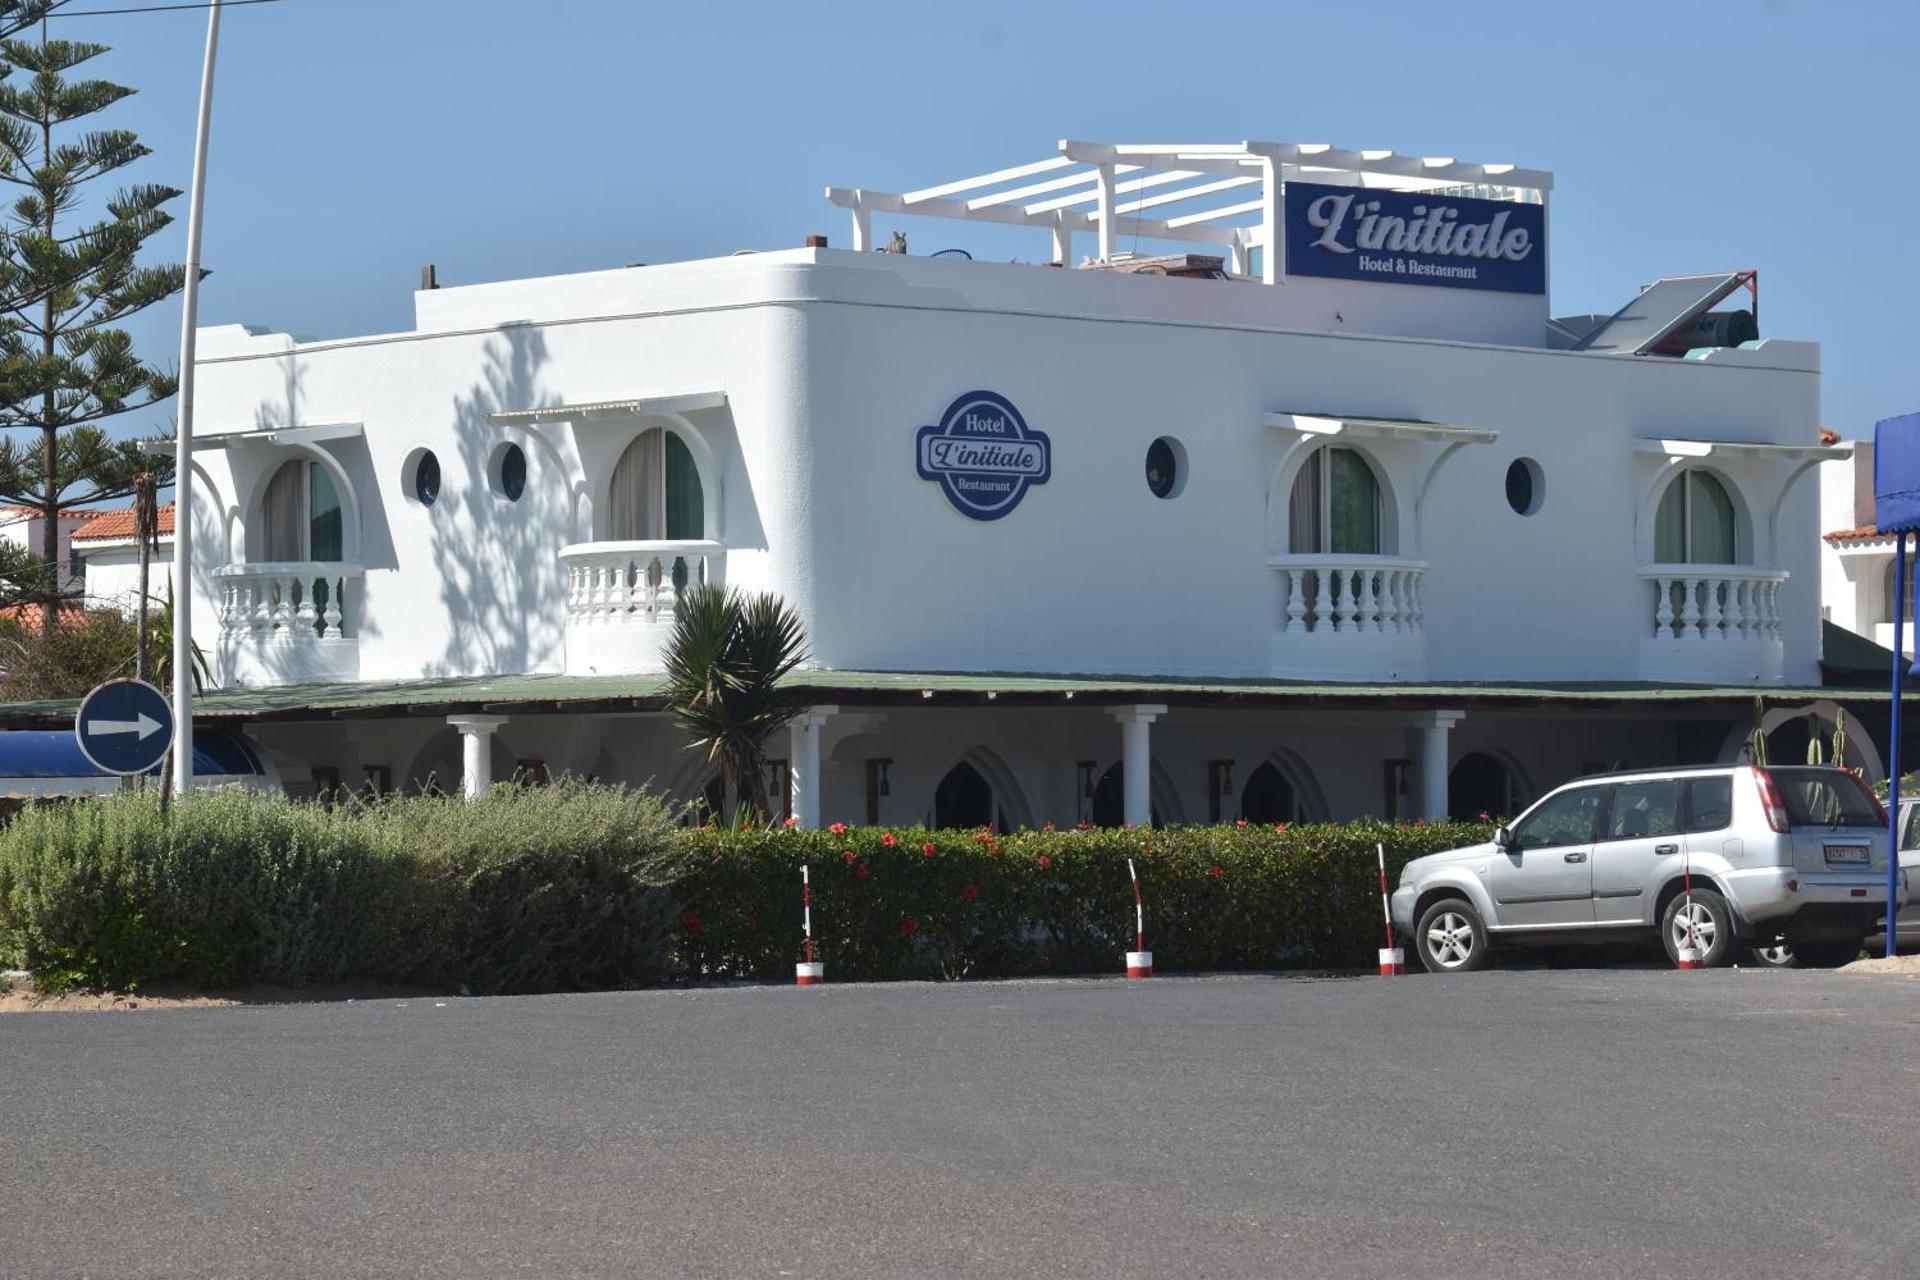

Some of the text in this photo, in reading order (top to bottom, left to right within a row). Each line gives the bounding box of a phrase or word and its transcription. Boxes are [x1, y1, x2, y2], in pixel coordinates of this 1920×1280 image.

[1308, 194, 1533, 261] L'initiale
[1359, 255, 1478, 279] Hotel & Restaurant
[966, 413, 1005, 433] Hotel
[935, 442, 1034, 468] L'initiale
[958, 478, 1011, 492] Restaurant
